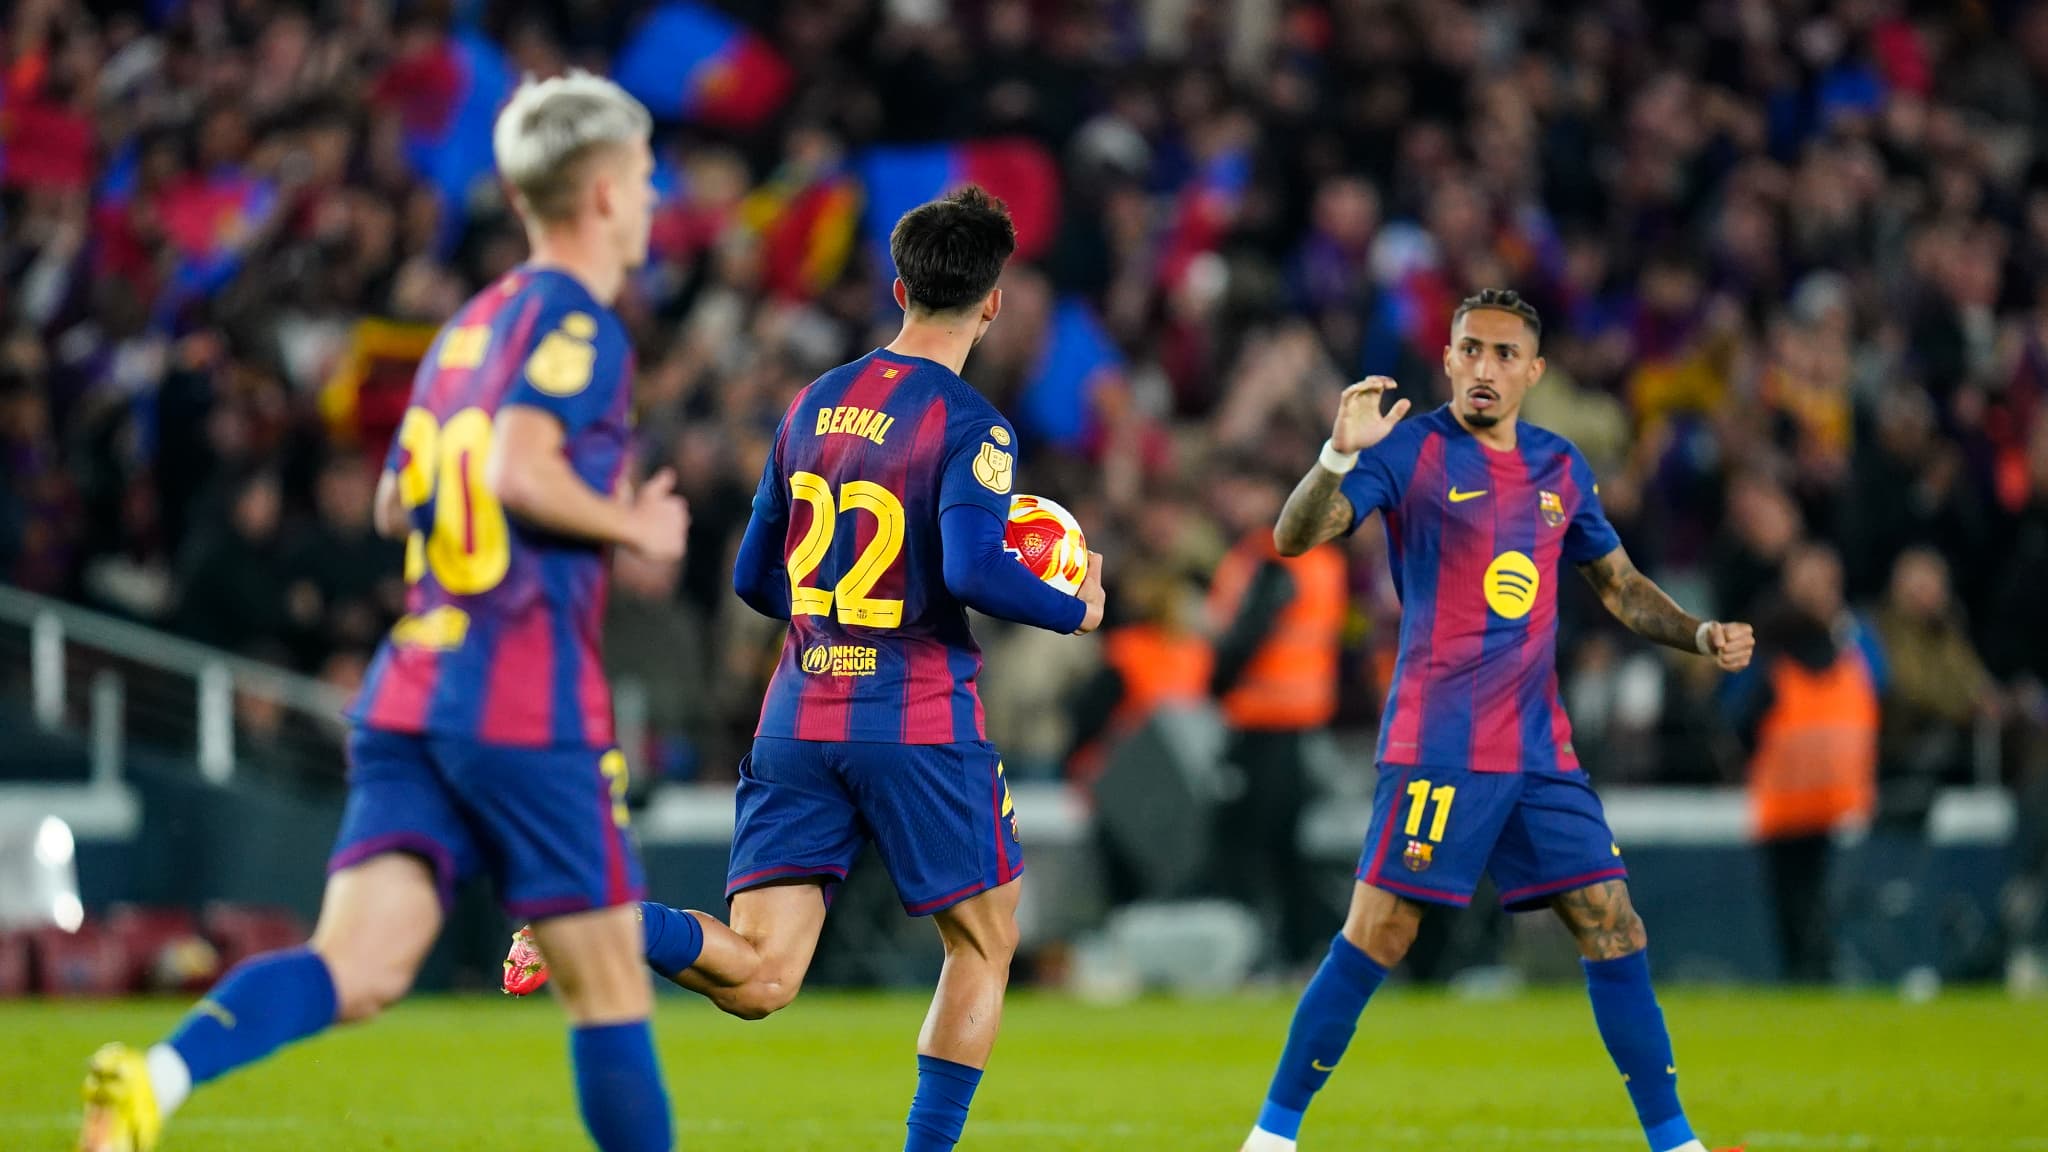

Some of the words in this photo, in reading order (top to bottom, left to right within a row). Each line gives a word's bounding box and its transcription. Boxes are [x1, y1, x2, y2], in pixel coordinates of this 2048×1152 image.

[815, 406, 895, 446] BERNAL
[787, 471, 905, 629] 22
[831, 646, 876, 657] NHCR
[832, 657, 876, 671] CNUR
[1404, 779, 1456, 842] 11
